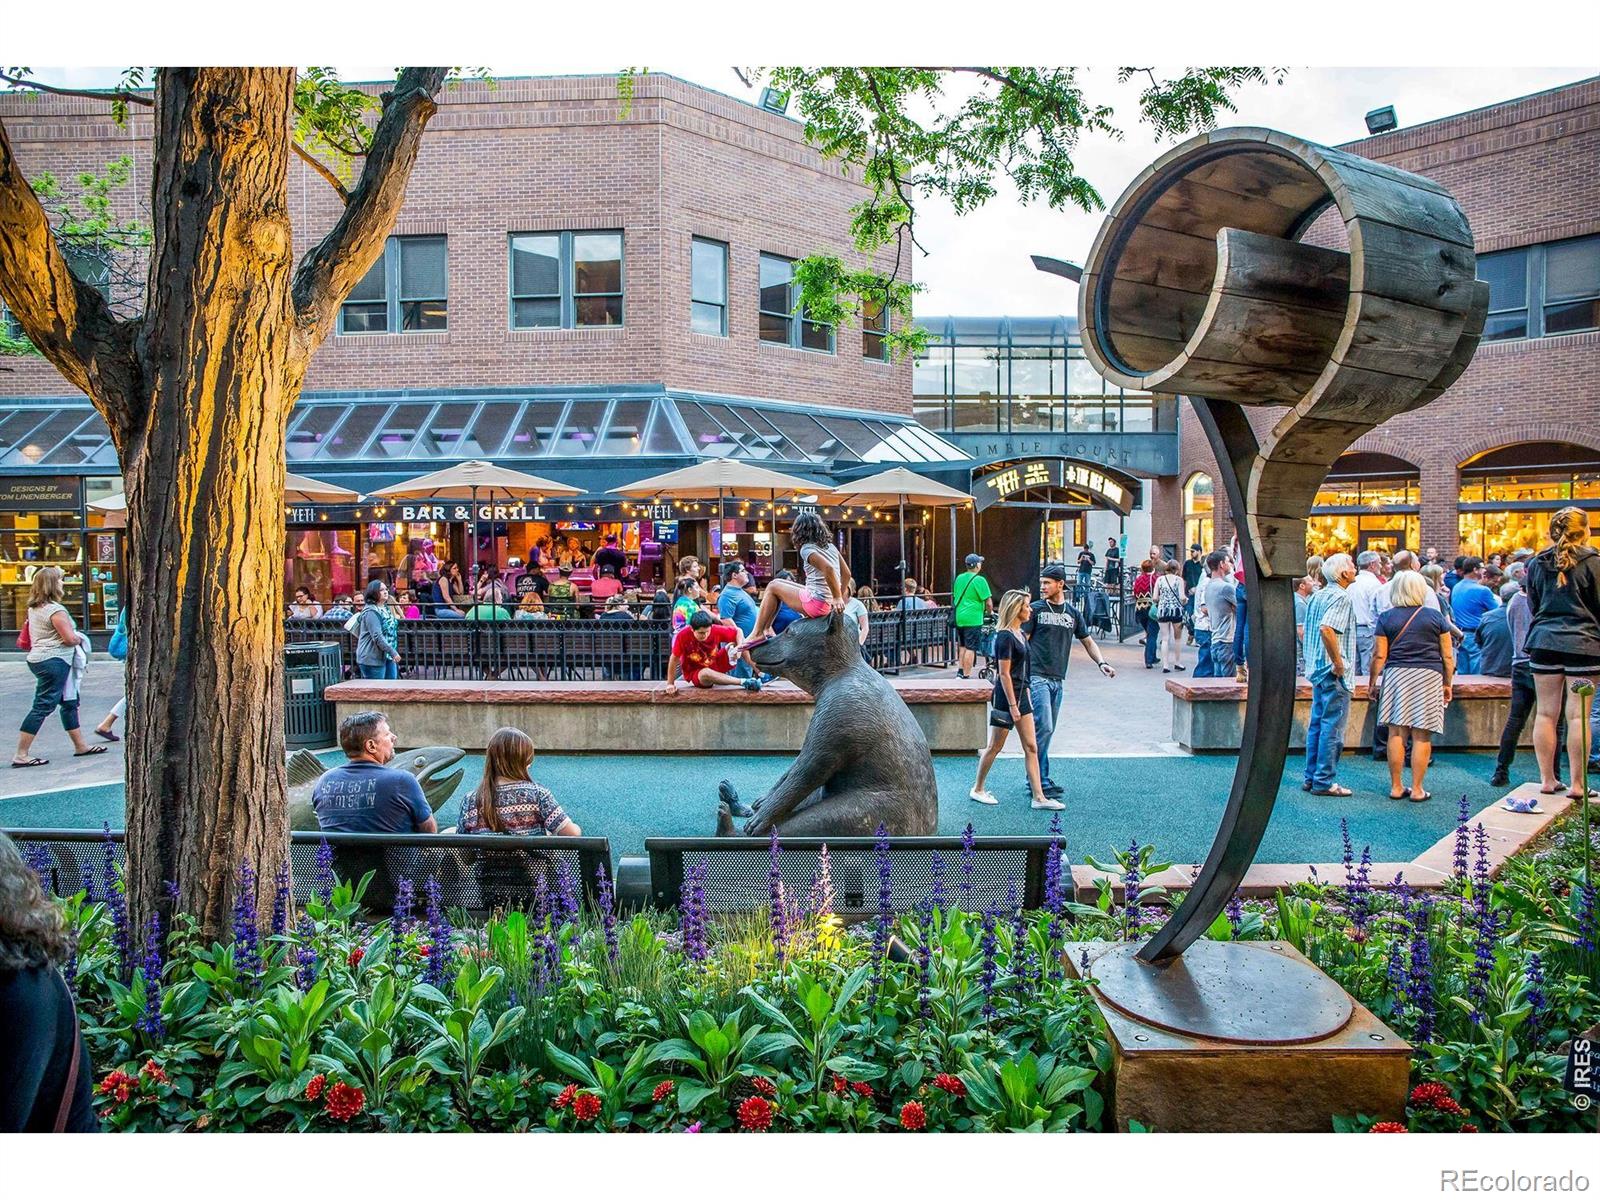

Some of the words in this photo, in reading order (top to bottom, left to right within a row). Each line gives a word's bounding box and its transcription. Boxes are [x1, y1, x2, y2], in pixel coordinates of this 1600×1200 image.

[970, 442, 1041, 457] IMBLE
[1060, 443, 1132, 463] COURT
[402, 506, 446, 520] BAR
[454, 506, 471, 520] &
[478, 506, 546, 520] GRILL
